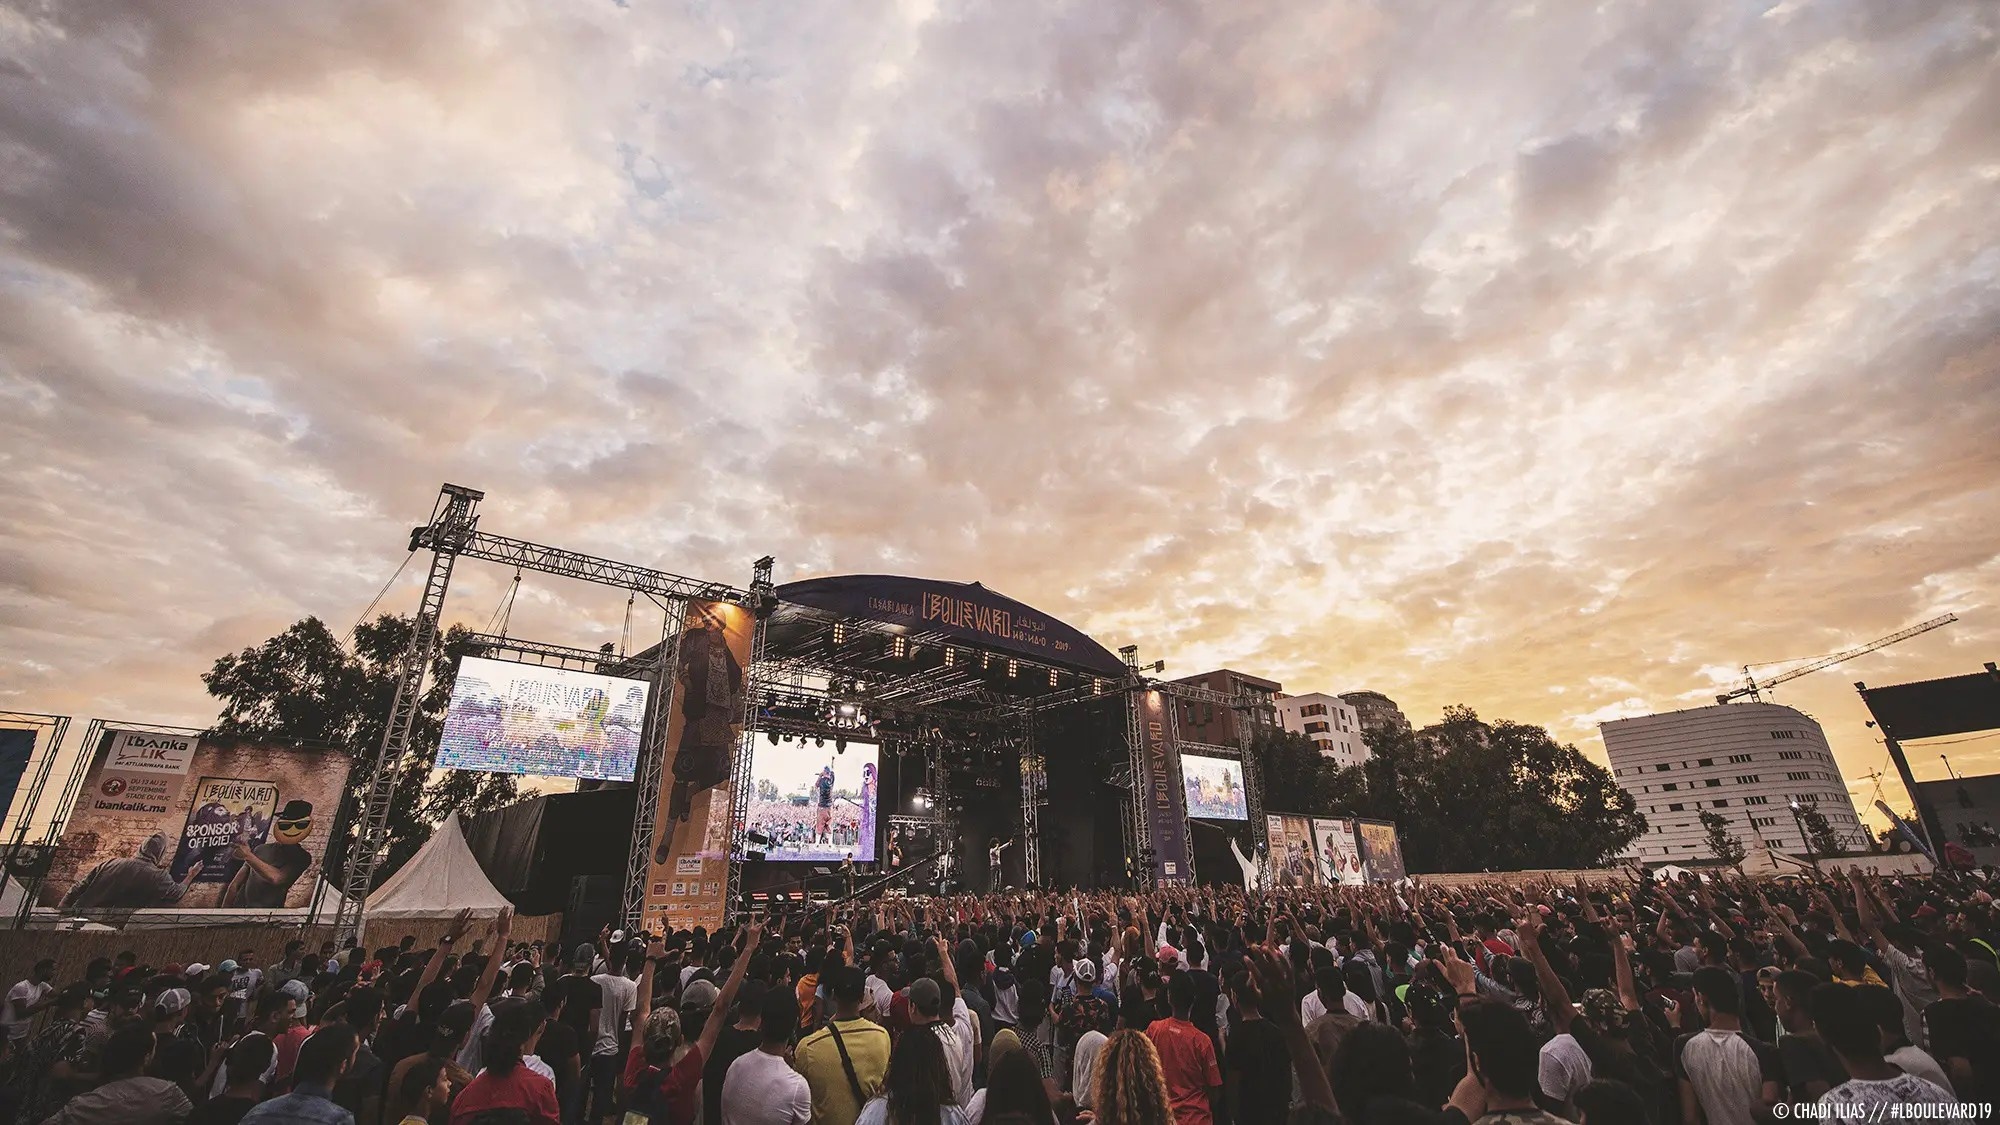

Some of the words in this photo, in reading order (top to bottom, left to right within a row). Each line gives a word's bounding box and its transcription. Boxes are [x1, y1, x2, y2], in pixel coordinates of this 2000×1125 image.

[868, 597, 914, 616] CASABLANCA
[922, 591, 1010, 638] L'BOULEVARD
[140, 748, 168, 760] LIK
[125, 792, 146, 800] STADE
[128, 786, 167, 794] SEPTEMBRE
[186, 822, 239, 837] SPONSOR
